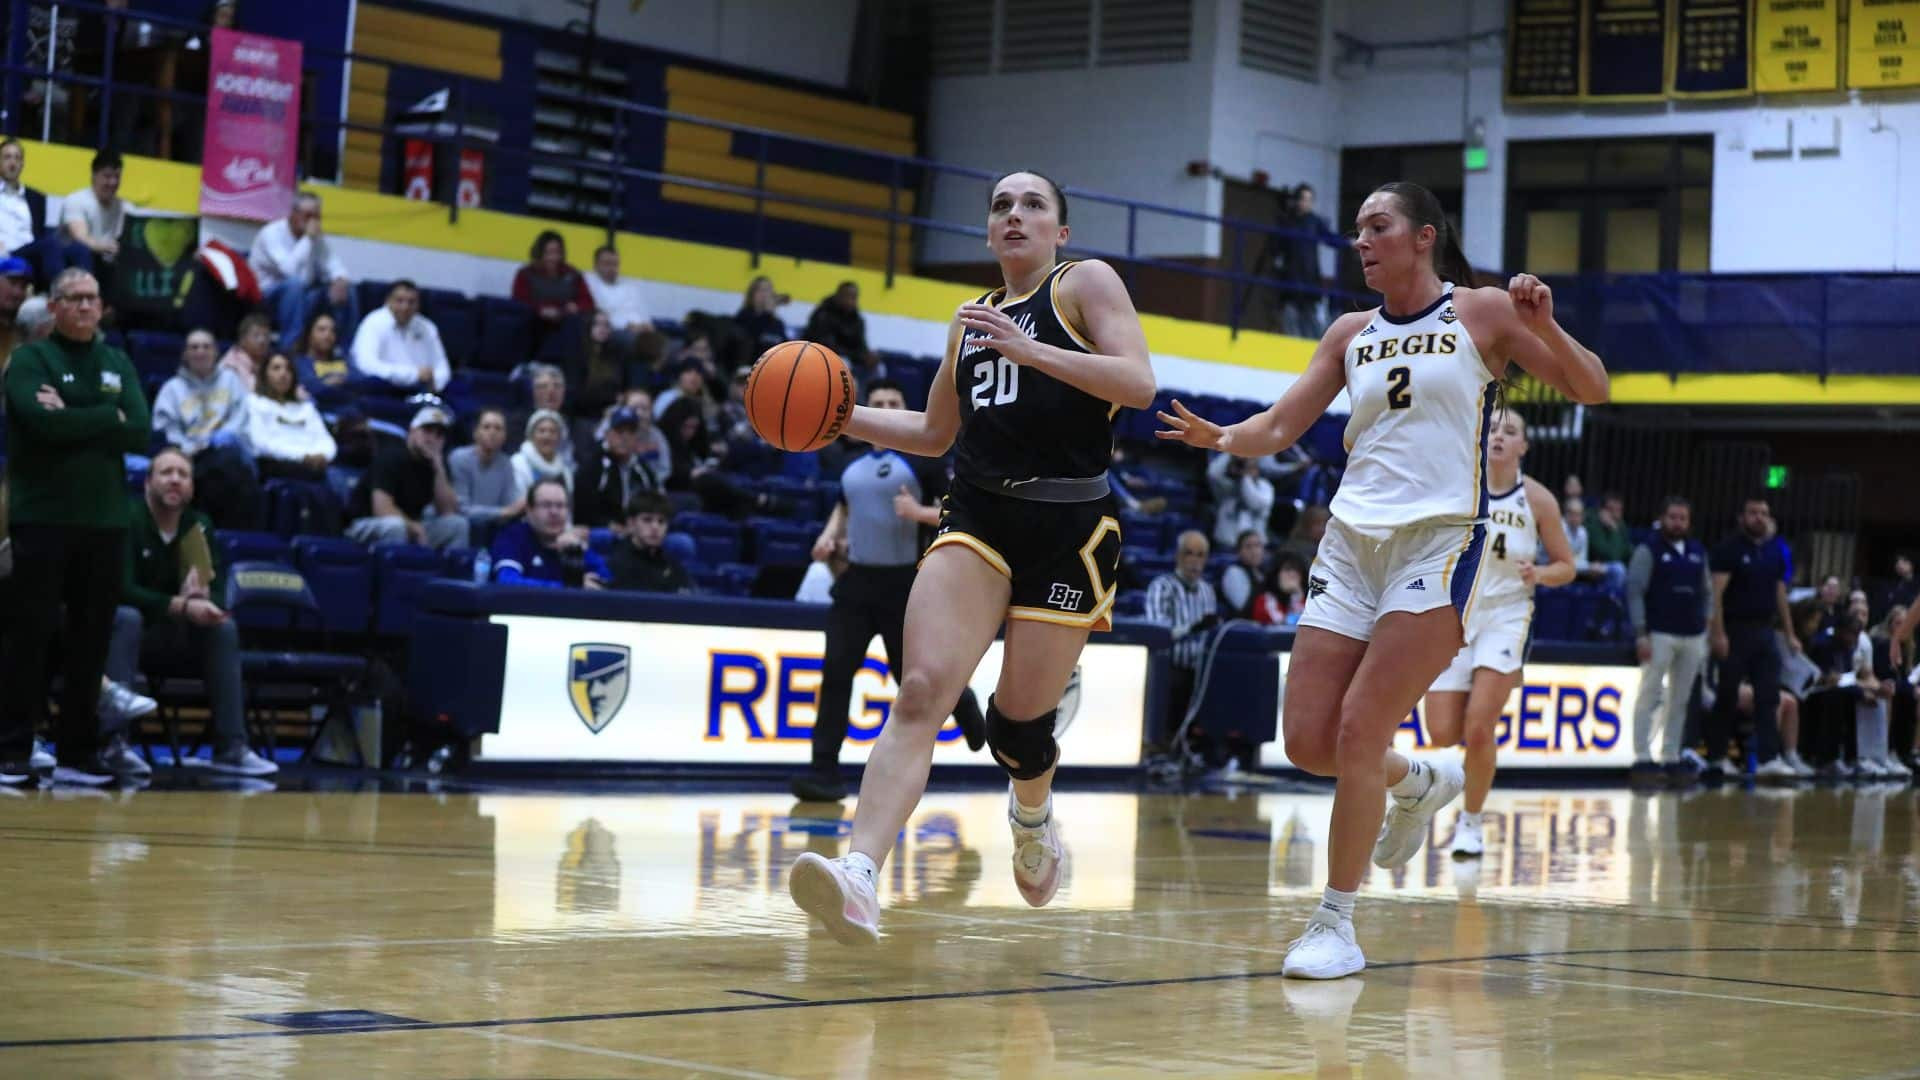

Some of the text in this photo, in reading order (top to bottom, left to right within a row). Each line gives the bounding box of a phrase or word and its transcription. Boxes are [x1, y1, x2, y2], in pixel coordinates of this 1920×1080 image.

[1356, 333, 1457, 368] REGIS
[971, 356, 1019, 412] 20
[1387, 366, 1412, 411] 2
[1491, 509, 1526, 529] GIS
[1491, 532, 1507, 561] 4
[1047, 582, 1084, 611] BH
[703, 649, 968, 742] REG
